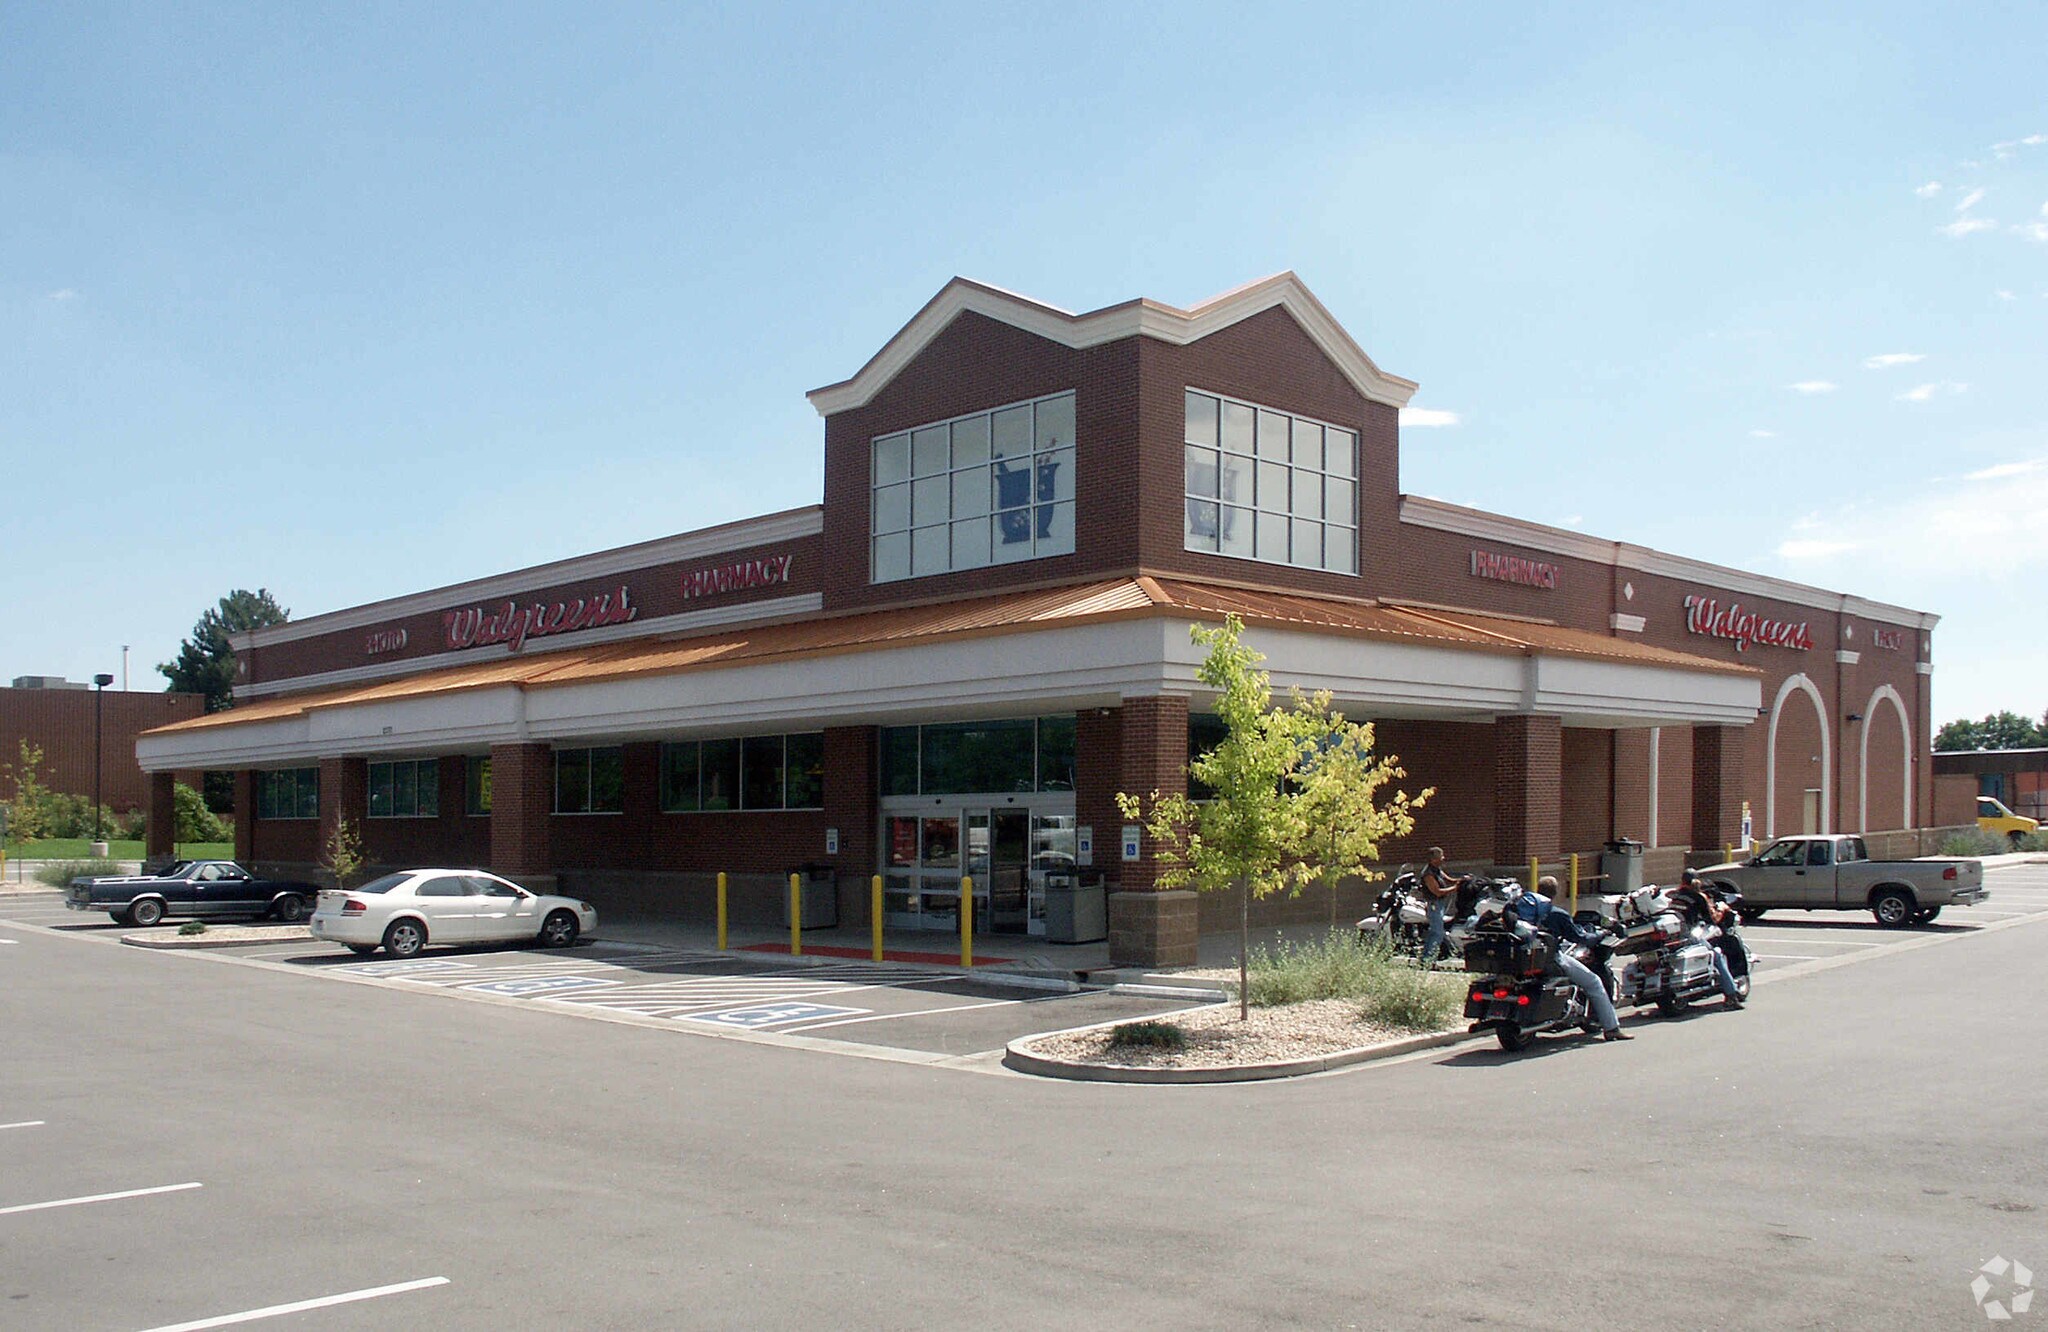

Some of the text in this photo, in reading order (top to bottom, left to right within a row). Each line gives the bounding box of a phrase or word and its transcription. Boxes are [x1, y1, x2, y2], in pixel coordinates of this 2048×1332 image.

[680, 554, 793, 599] PHARMACY
[1470, 549, 1563, 590] PHARMACY
[443, 586, 637, 653] Walgreens
[1683, 595, 1814, 652] Walgreens
